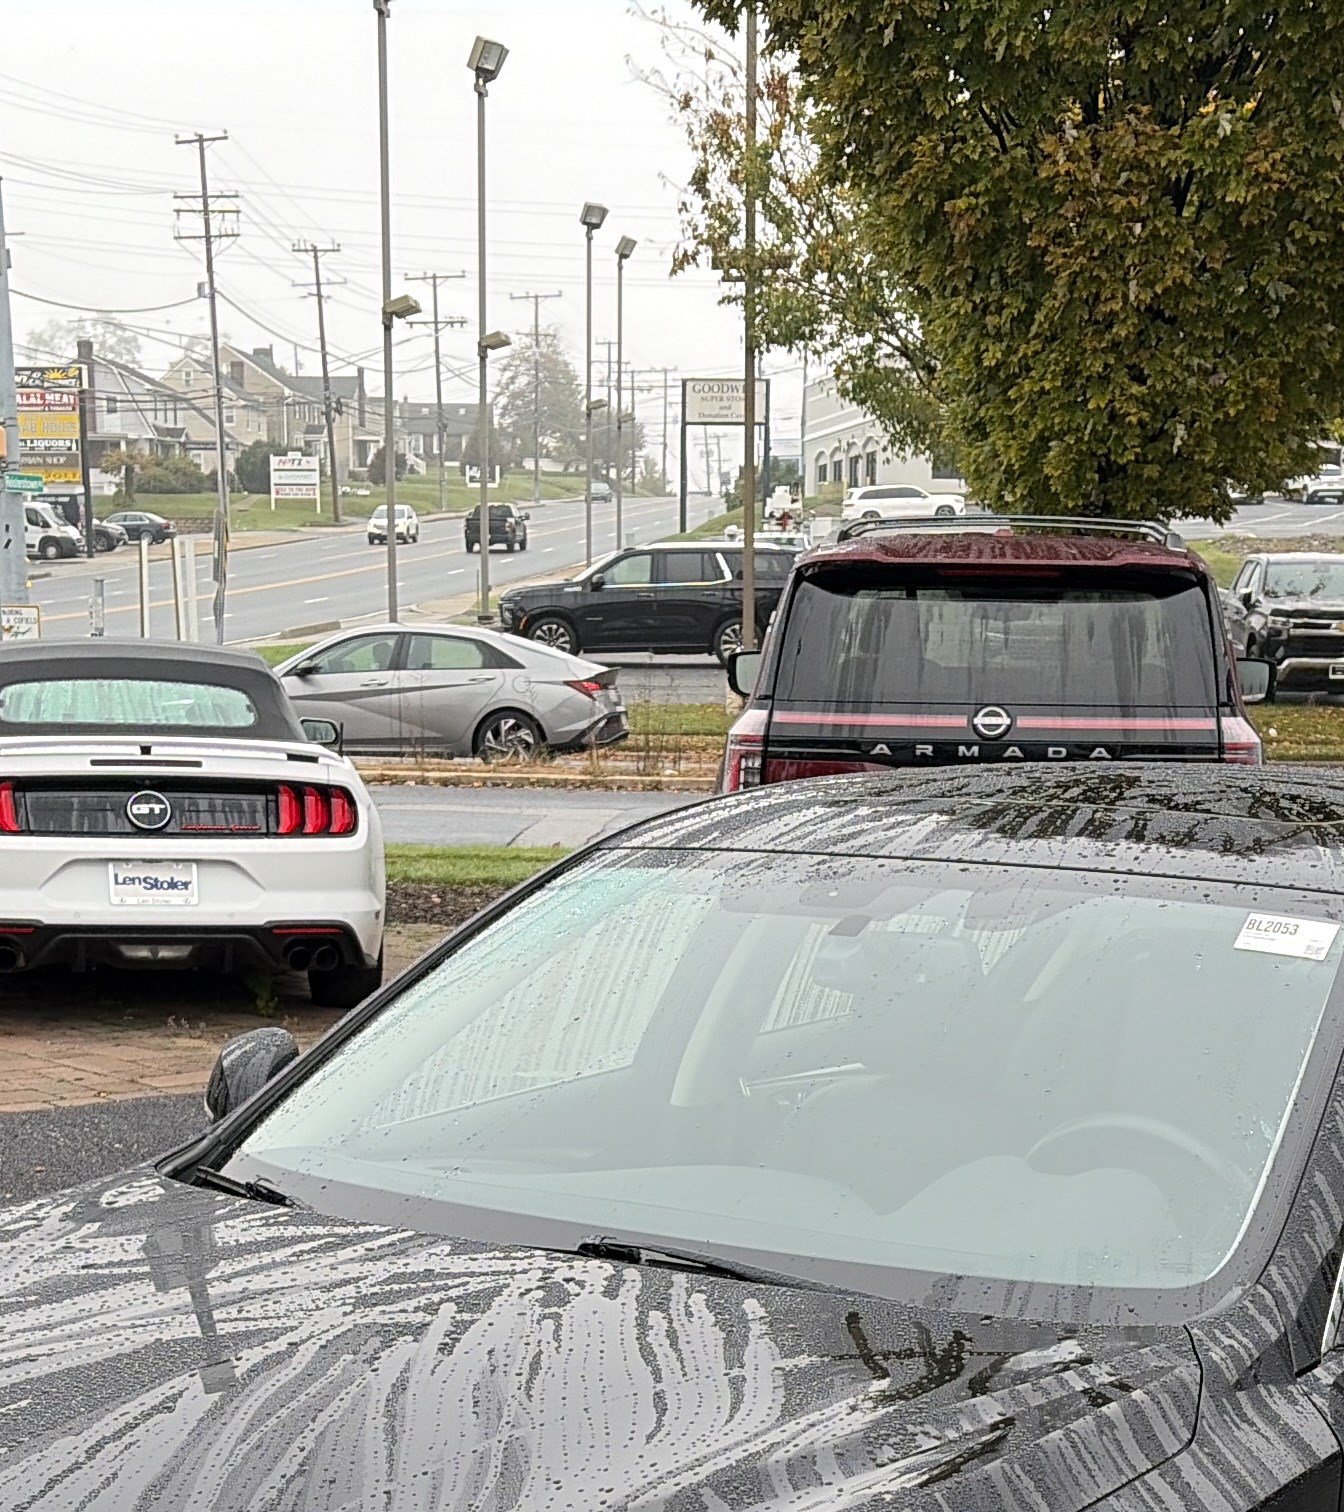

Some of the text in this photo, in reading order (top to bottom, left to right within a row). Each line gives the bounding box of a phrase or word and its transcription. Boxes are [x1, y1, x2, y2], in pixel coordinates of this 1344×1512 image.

[17, 393, 41, 404] ALAL
[26, 439, 71, 447] LIQUORS
[869, 743, 1112, 759] ARMADA
[131, 803, 166, 814] GT
[1245, 918, 1300, 936] BL2053
